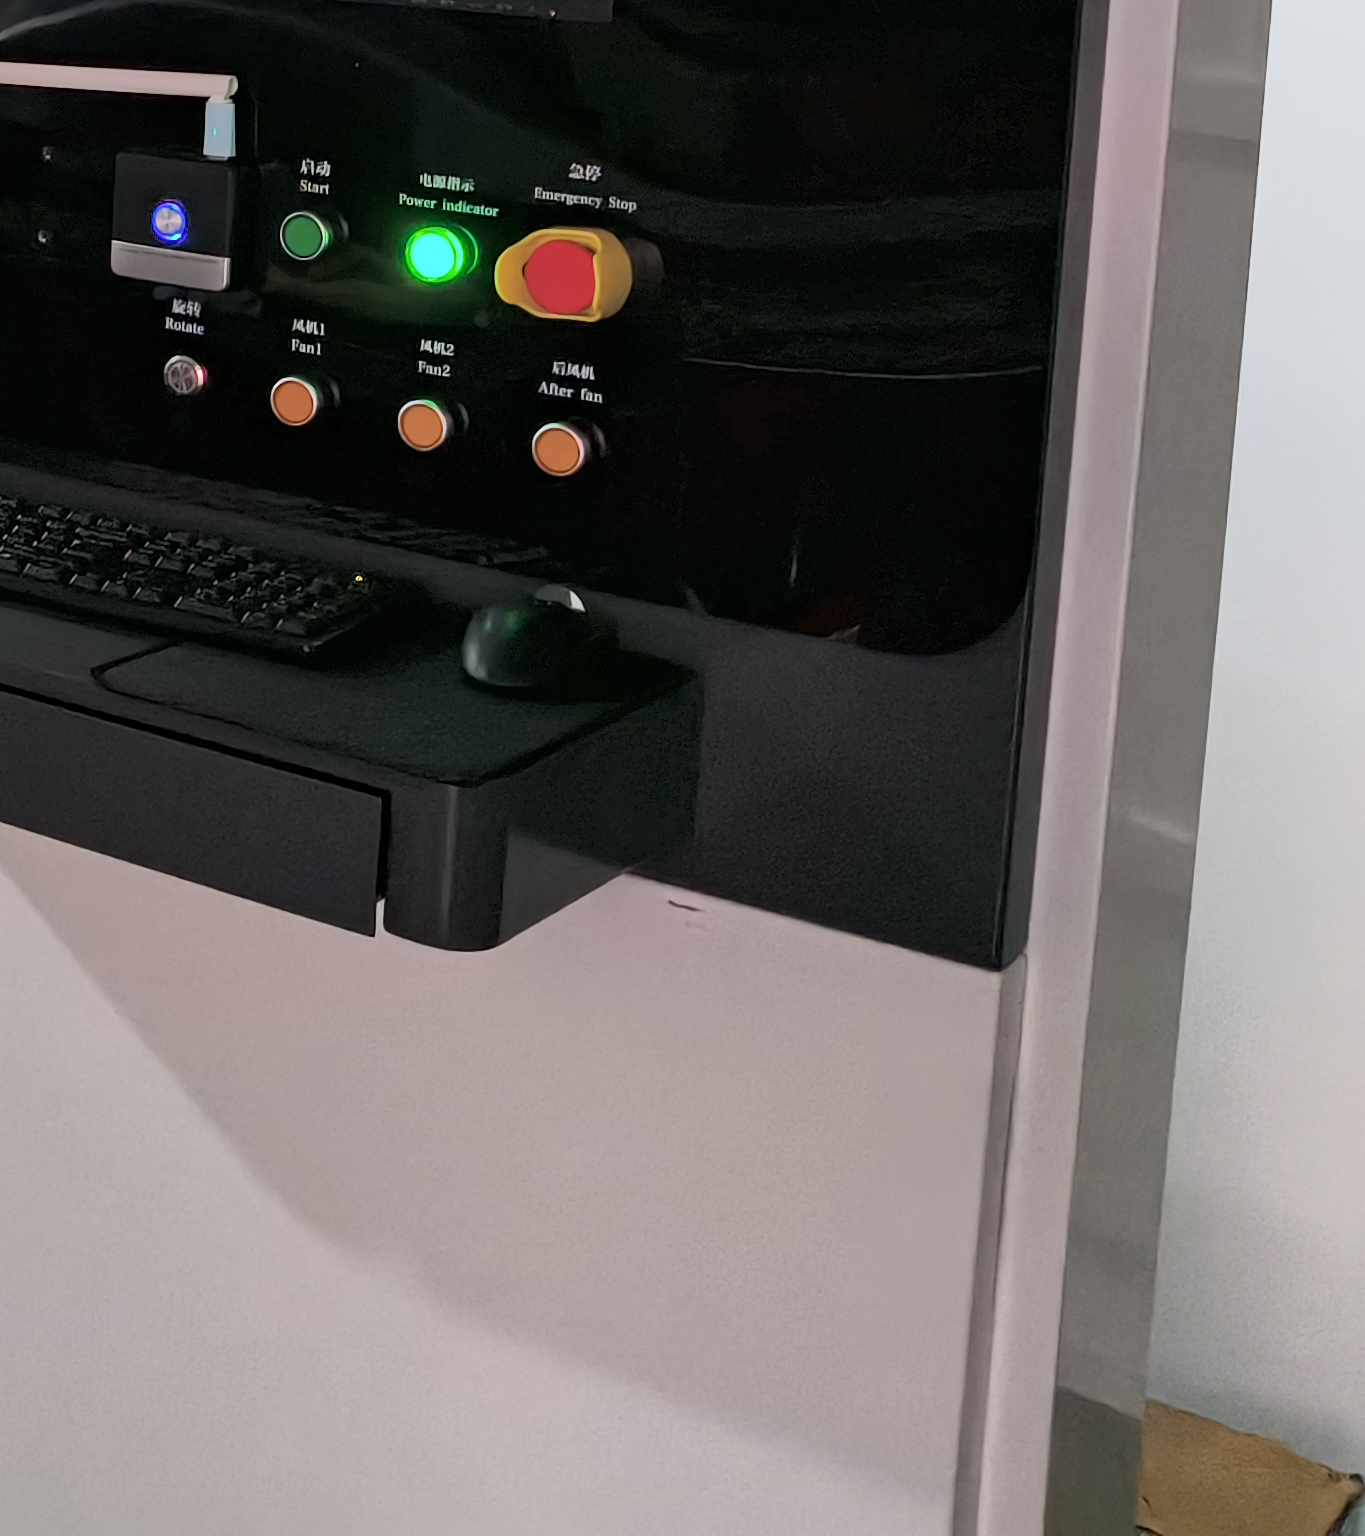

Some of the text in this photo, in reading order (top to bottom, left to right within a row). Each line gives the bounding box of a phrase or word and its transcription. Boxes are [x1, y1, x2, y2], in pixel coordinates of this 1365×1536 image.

[300, 157, 332, 177] 启动
[568, 162, 602, 182] 急停
[299, 179, 330, 196] Start
[398, 192, 437, 209] Power
[534, 186, 637, 214] Emergency Stop
[165, 316, 205, 335] Rotate
[291, 338, 322, 356] Fan1
[418, 360, 451, 377] Fan2
[537, 381, 604, 405] After fan
